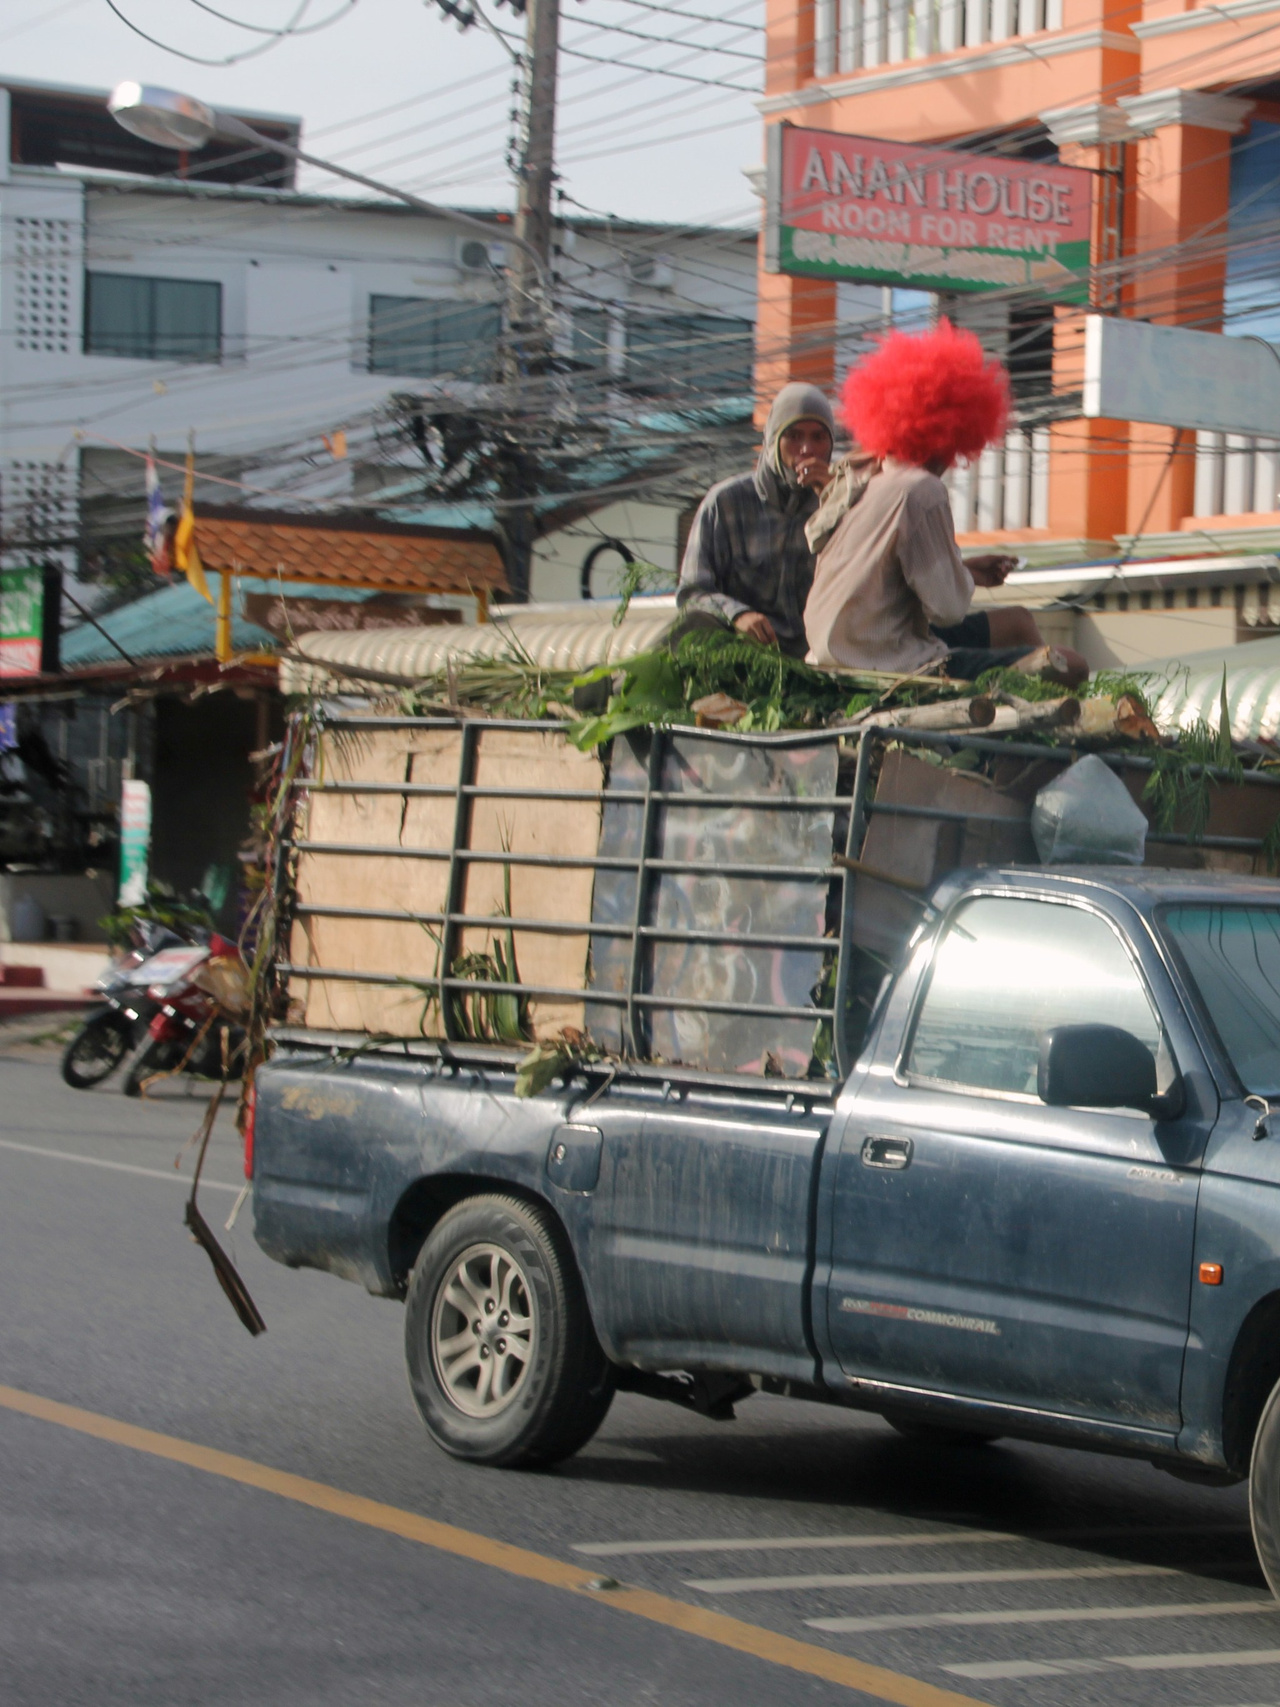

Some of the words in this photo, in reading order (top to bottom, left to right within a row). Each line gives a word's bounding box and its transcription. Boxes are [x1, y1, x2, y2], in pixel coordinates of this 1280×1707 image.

[802, 146, 927, 207] ANAN
[937, 170, 1072, 226] HOUSE
[822, 201, 911, 239] ROOM
[920, 213, 979, 246] FOR
[986, 222, 1062, 256] RENT
